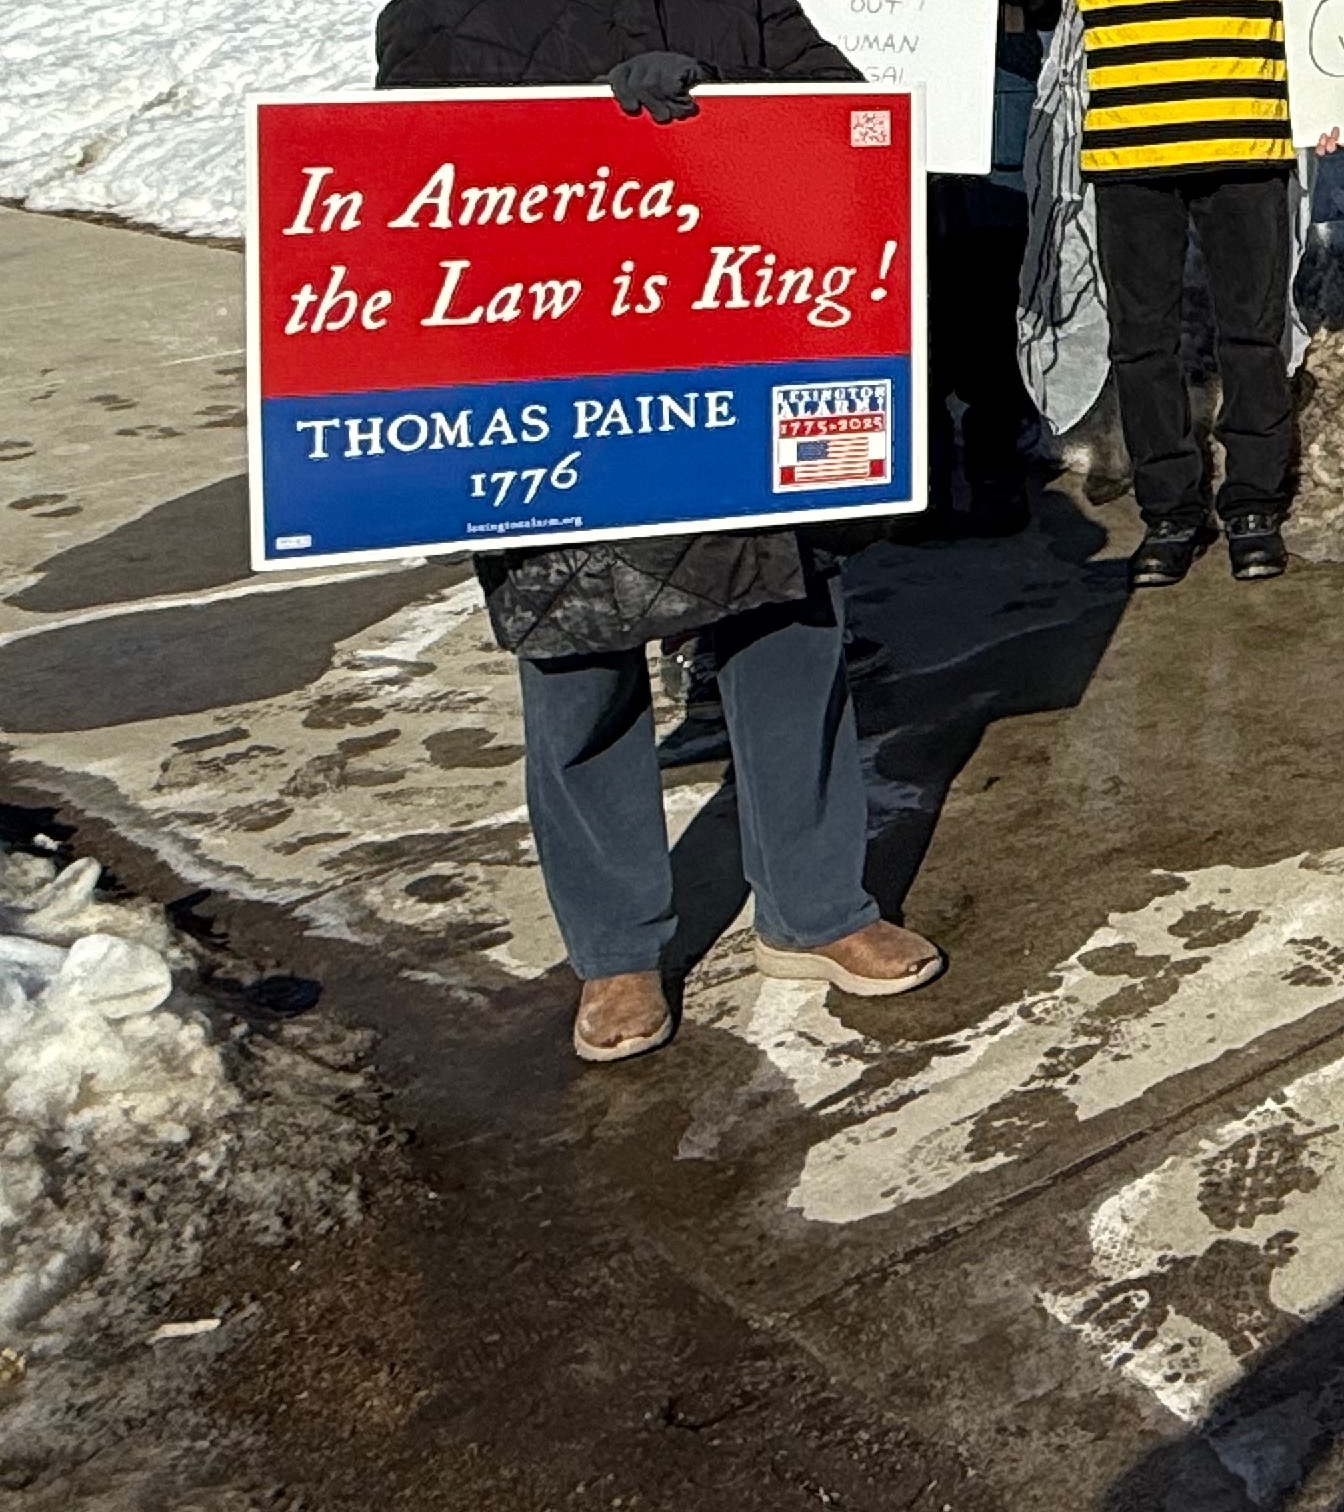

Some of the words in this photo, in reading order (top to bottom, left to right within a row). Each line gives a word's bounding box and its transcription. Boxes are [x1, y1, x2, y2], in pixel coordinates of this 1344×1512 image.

[838, 32, 919, 54] UMAN
[282, 166, 364, 236] In
[387, 162, 700, 233] America,
[284, 264, 392, 336] the
[420, 259, 582, 327] Law
[611, 260, 669, 317] is
[297, 403, 551, 460] THOMAS
[573, 390, 737, 440] PAINE
[469, 450, 583, 508] 1776
